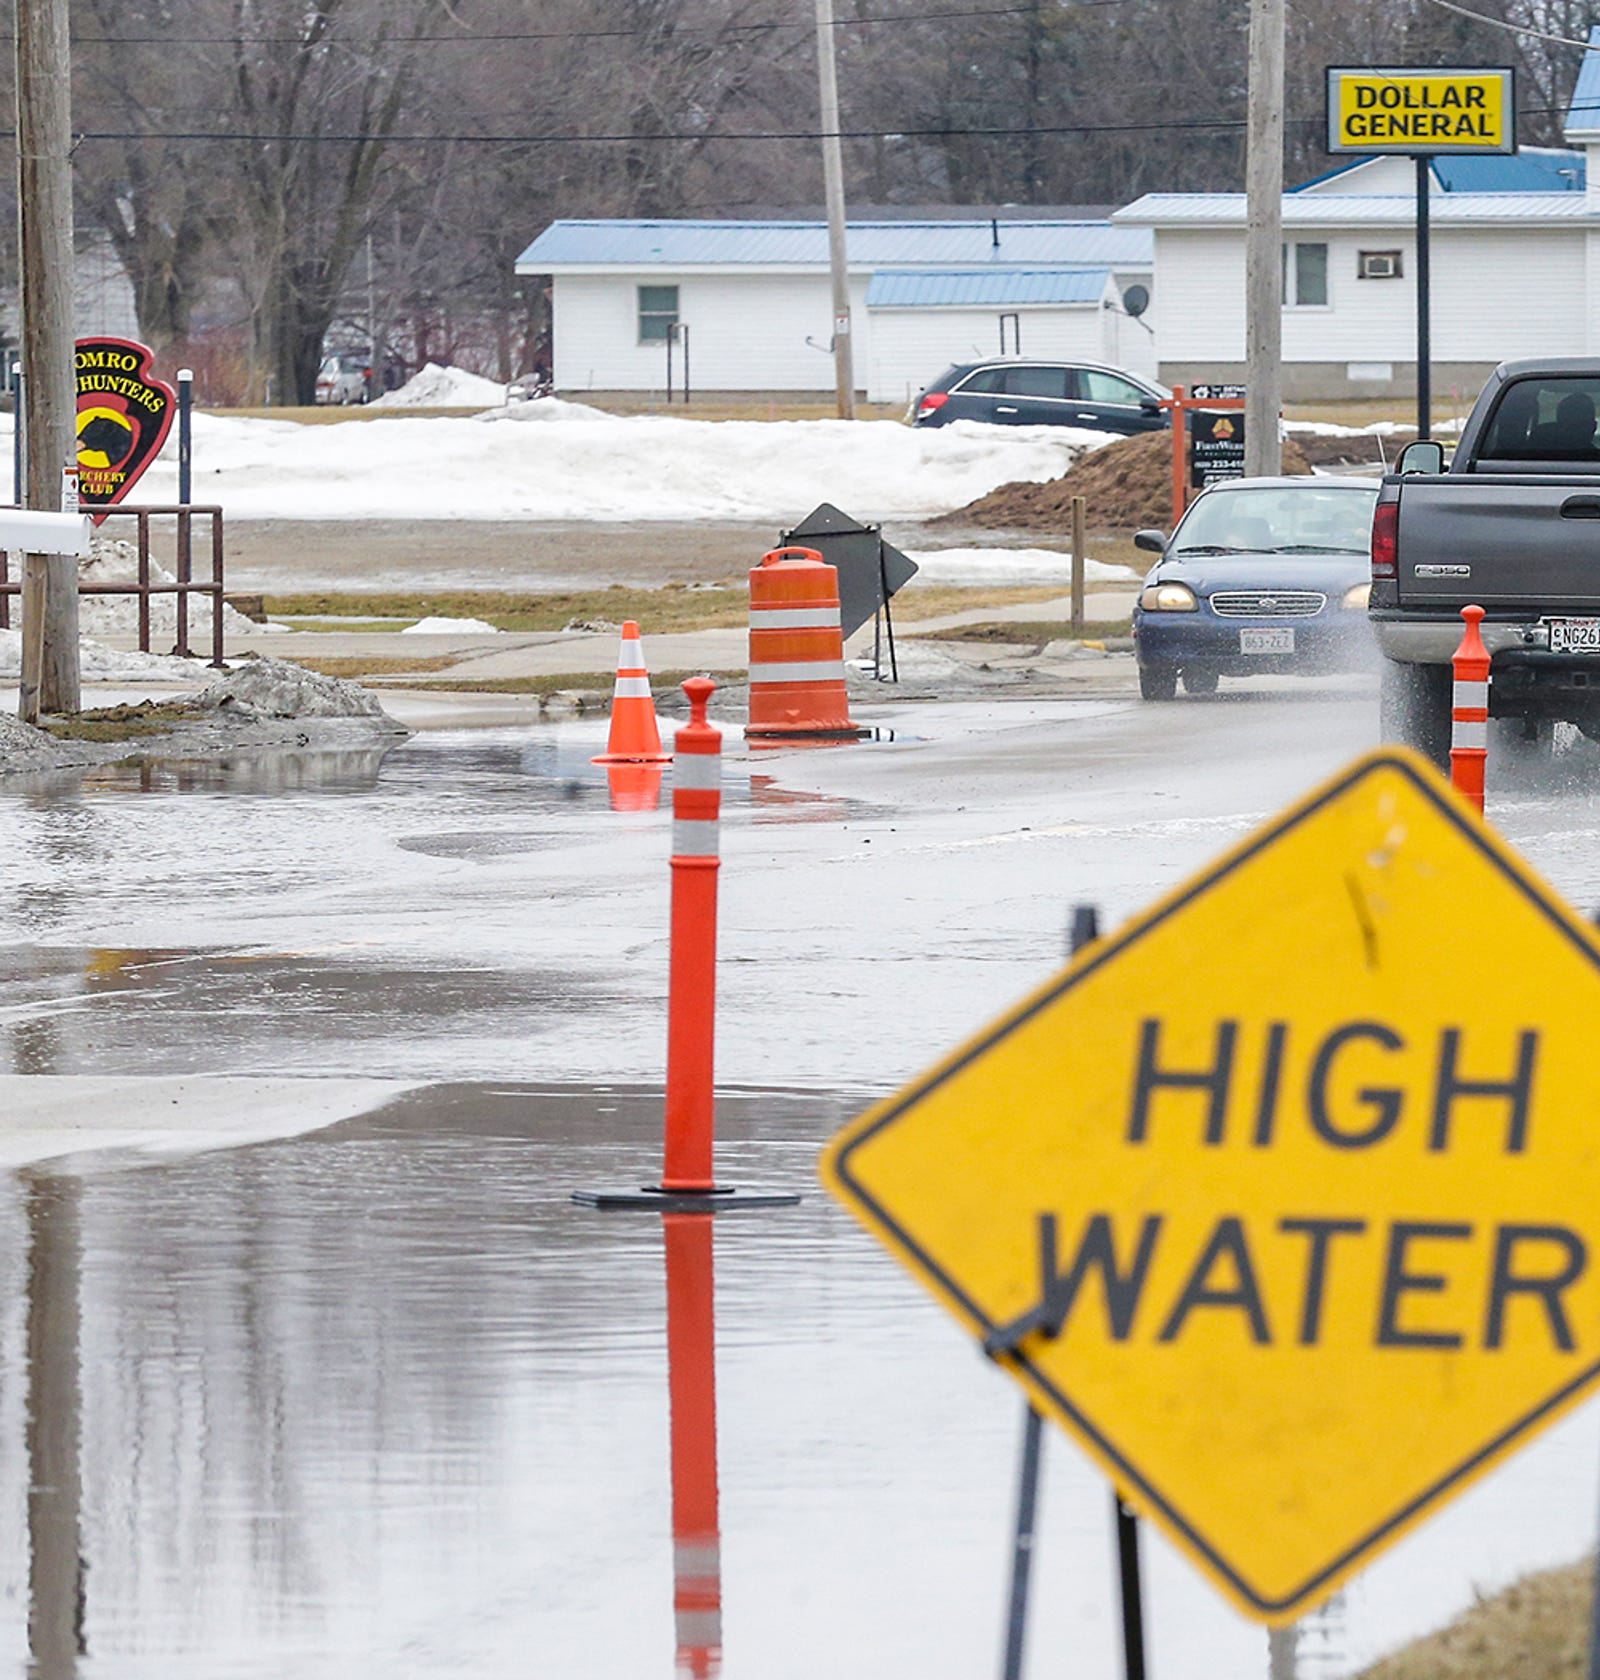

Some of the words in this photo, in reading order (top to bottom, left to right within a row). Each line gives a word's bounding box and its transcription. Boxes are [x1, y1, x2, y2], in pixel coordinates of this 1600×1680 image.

[1355, 86, 1486, 109] DOLLAR
[1345, 113, 1495, 137] GENERAL
[74, 352, 138, 372] OMRO
[75, 374, 164, 413] HUNTERS
[81, 483, 114, 494] CLUB
[1124, 1016, 1539, 1155] HIGH
[1037, 1212, 1589, 1354] WATER
